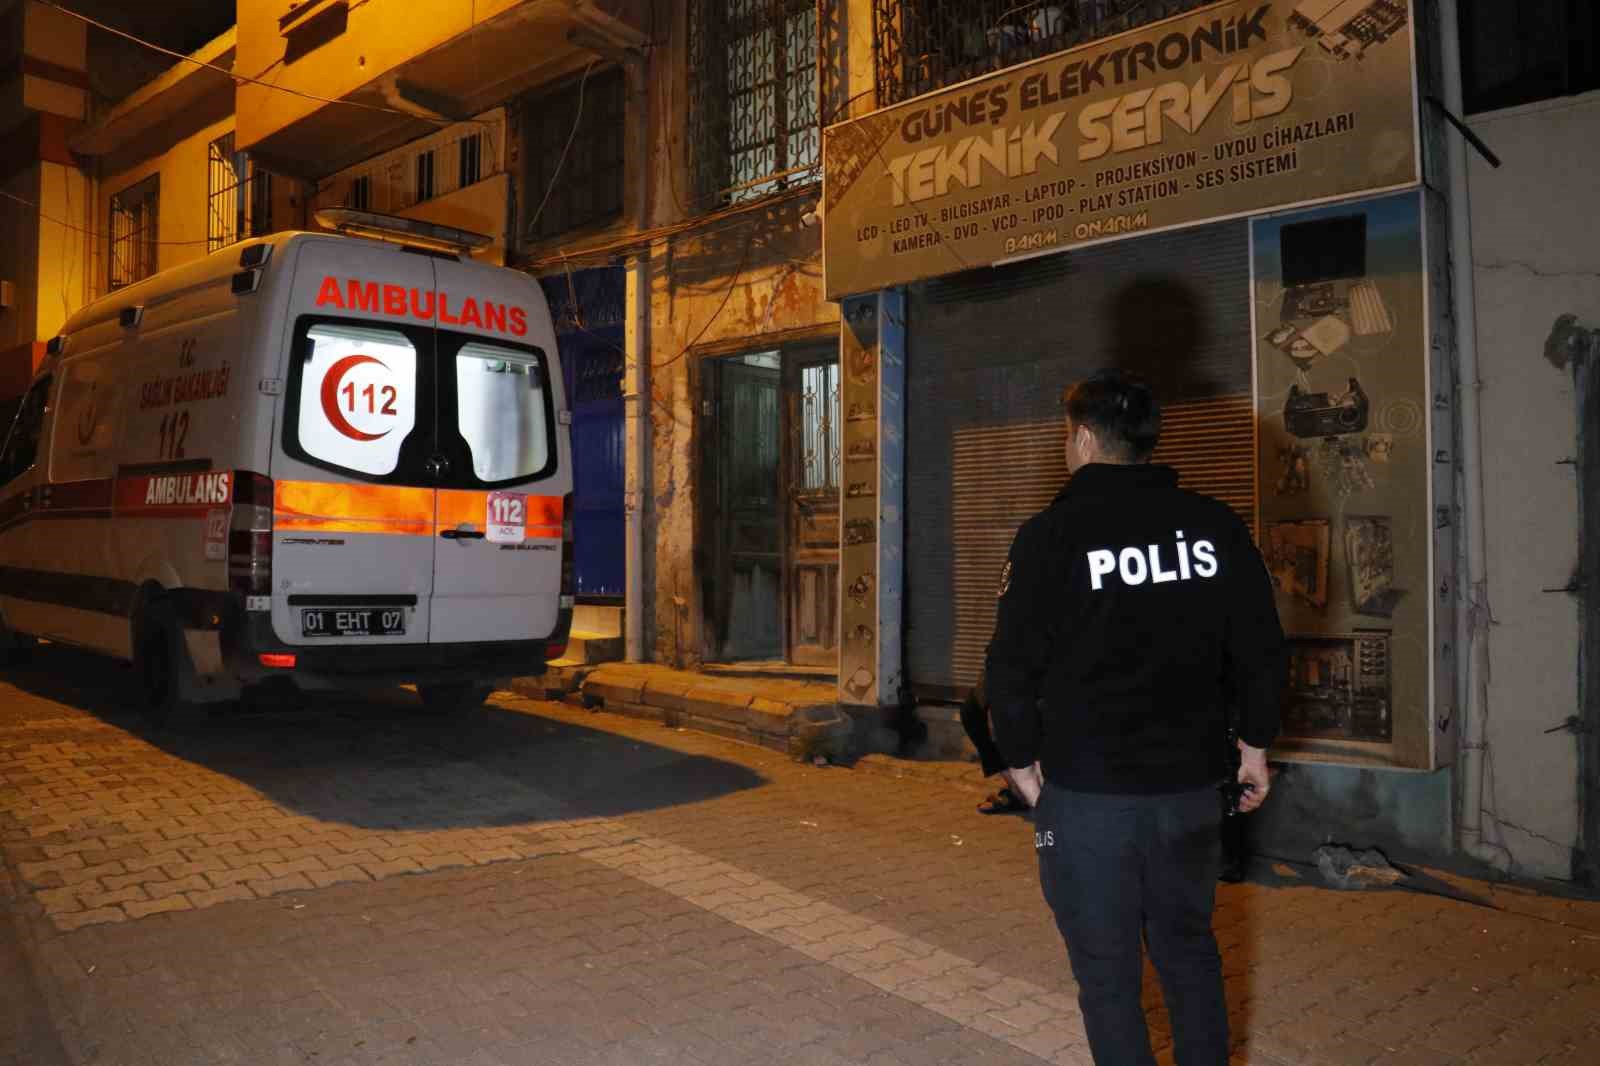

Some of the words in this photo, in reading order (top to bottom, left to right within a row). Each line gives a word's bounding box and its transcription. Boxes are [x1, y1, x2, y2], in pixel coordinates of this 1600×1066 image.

[902, 83, 1011, 143] GÜNEŞ
[857, 225, 878, 241] LCD
[890, 217, 910, 234] LED
[914, 212, 928, 228] TV
[1025, 179, 1075, 202] LAPTOP
[1096, 150, 1196, 187] PROJEKSİYON
[1214, 135, 1256, 161] UYDU
[1263, 112, 1355, 150] CİHAZLARI
[893, 231, 941, 254] KAMERA
[954, 222, 978, 240] DVD
[992, 214, 1017, 232] VCD
[1079, 194, 1114, 214] PLAY
[1118, 180, 1178, 206] STATION
[1196, 168, 1225, 190] SES
[1230, 148, 1297, 183] SİSTEMİ
[1005, 229, 1057, 252] BAKIM
[1075, 212, 1147, 240] ONARIM
[315, 275, 528, 337] AMBULANS
[342, 382, 397, 416] 112
[159, 410, 190, 460] 112
[145, 473, 229, 504] AMBULANS
[493, 498, 522, 523] 112
[1087, 530, 1218, 590] POLİS
[306, 612, 323, 630] 01
[336, 612, 371, 630] EHT
[382, 611, 400, 629] 07
